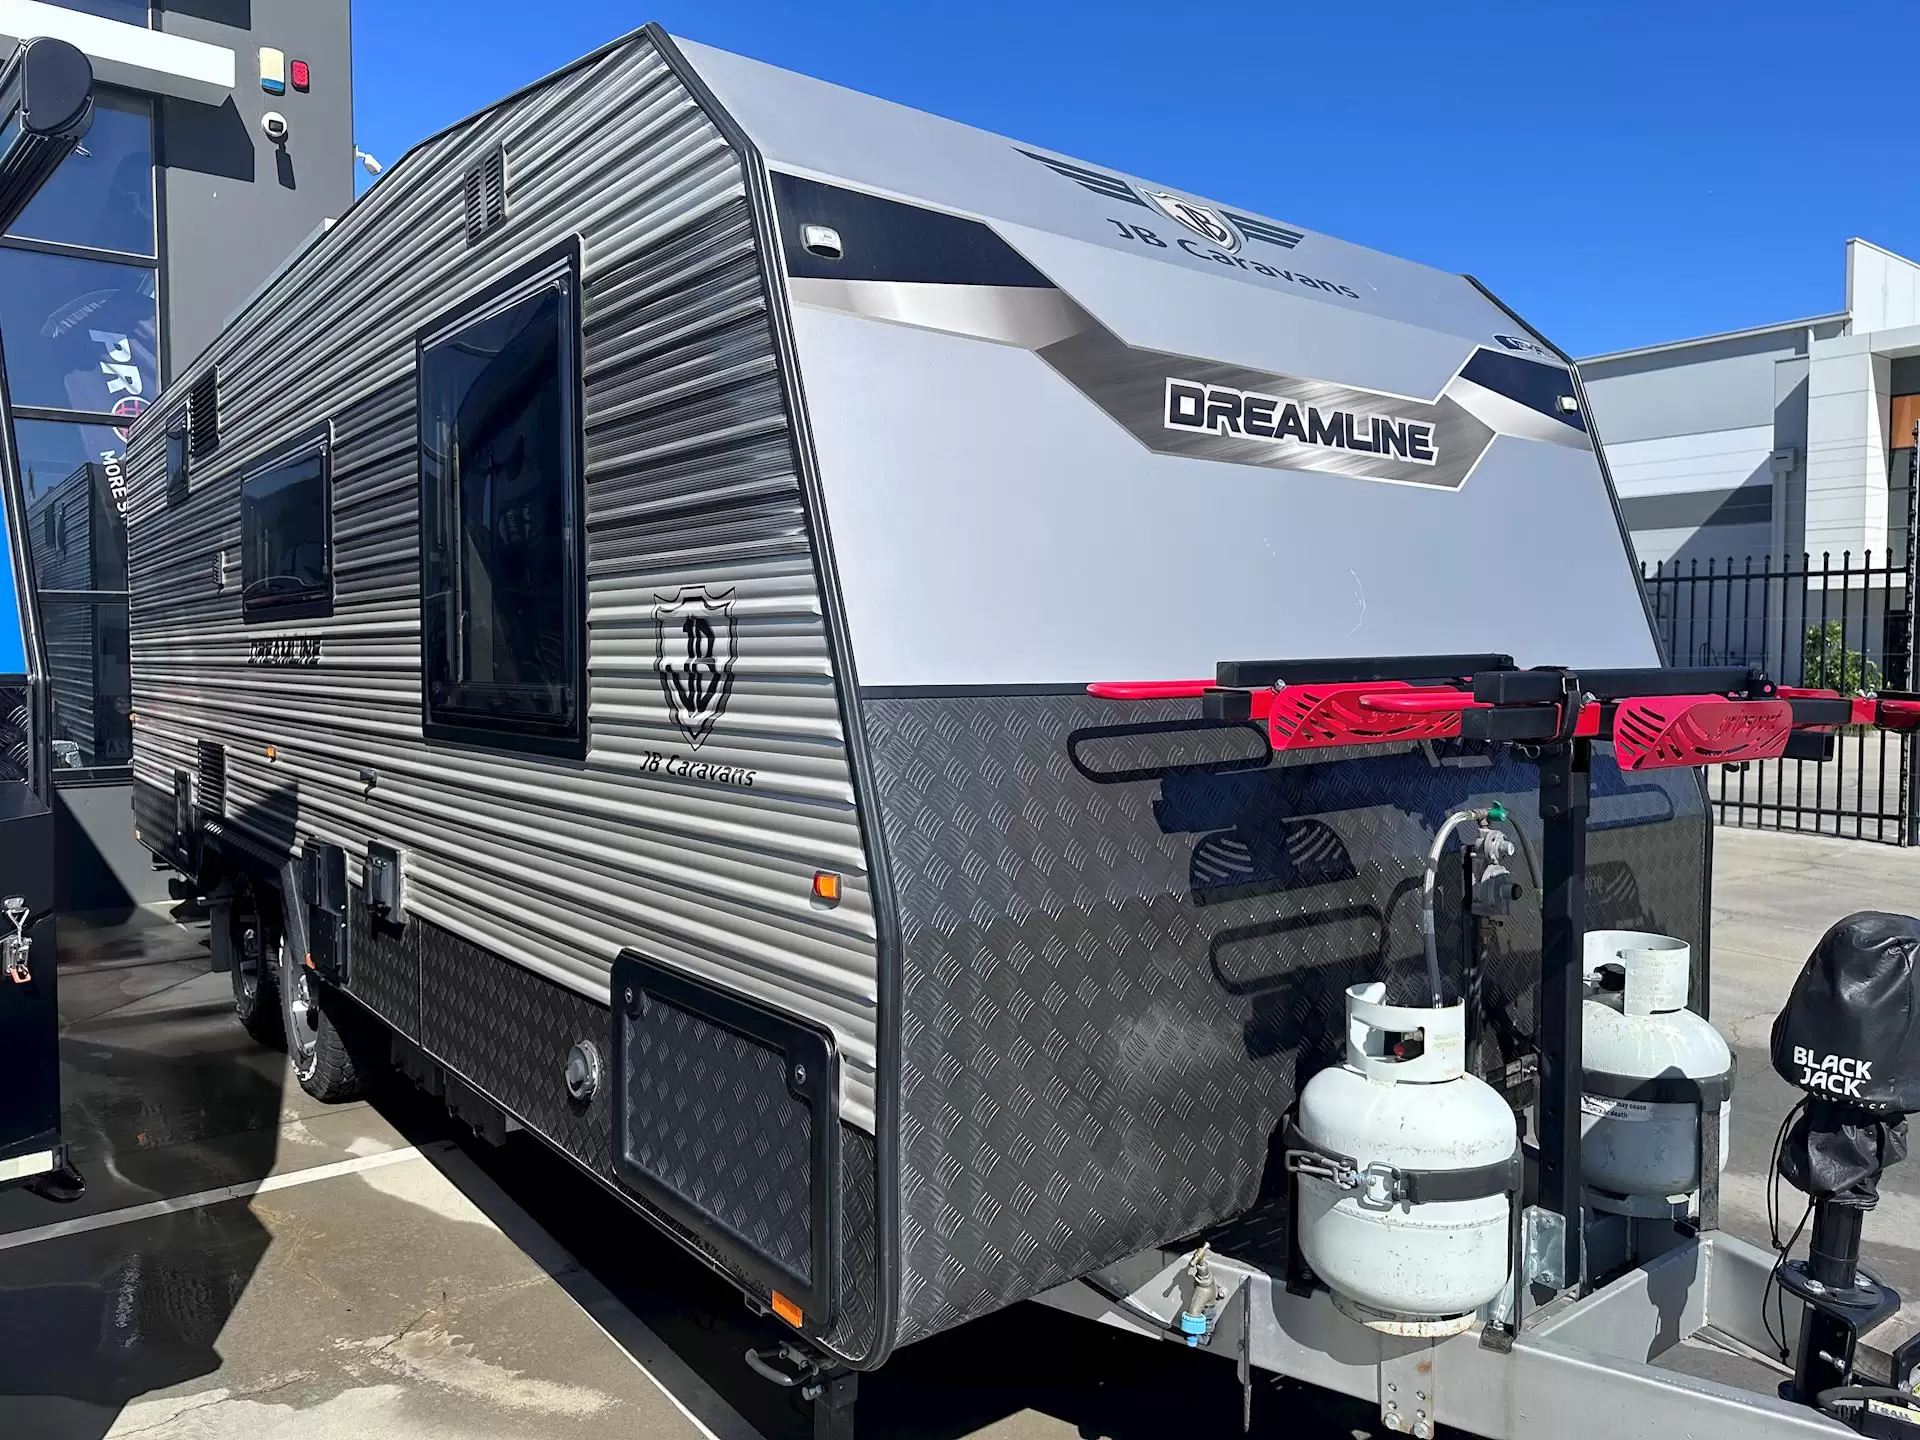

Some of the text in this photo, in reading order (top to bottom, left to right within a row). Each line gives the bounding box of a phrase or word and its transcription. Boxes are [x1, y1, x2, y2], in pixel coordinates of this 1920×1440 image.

[1106, 217, 1360, 299] JB Caravans
[1165, 378, 1438, 465] DREAMLINE
[100, 449, 127, 499] MORE
[640, 751, 756, 787] JB Caravans
[1794, 1046, 1872, 1080] BLACK
[1800, 1067, 1862, 1098] JACK
